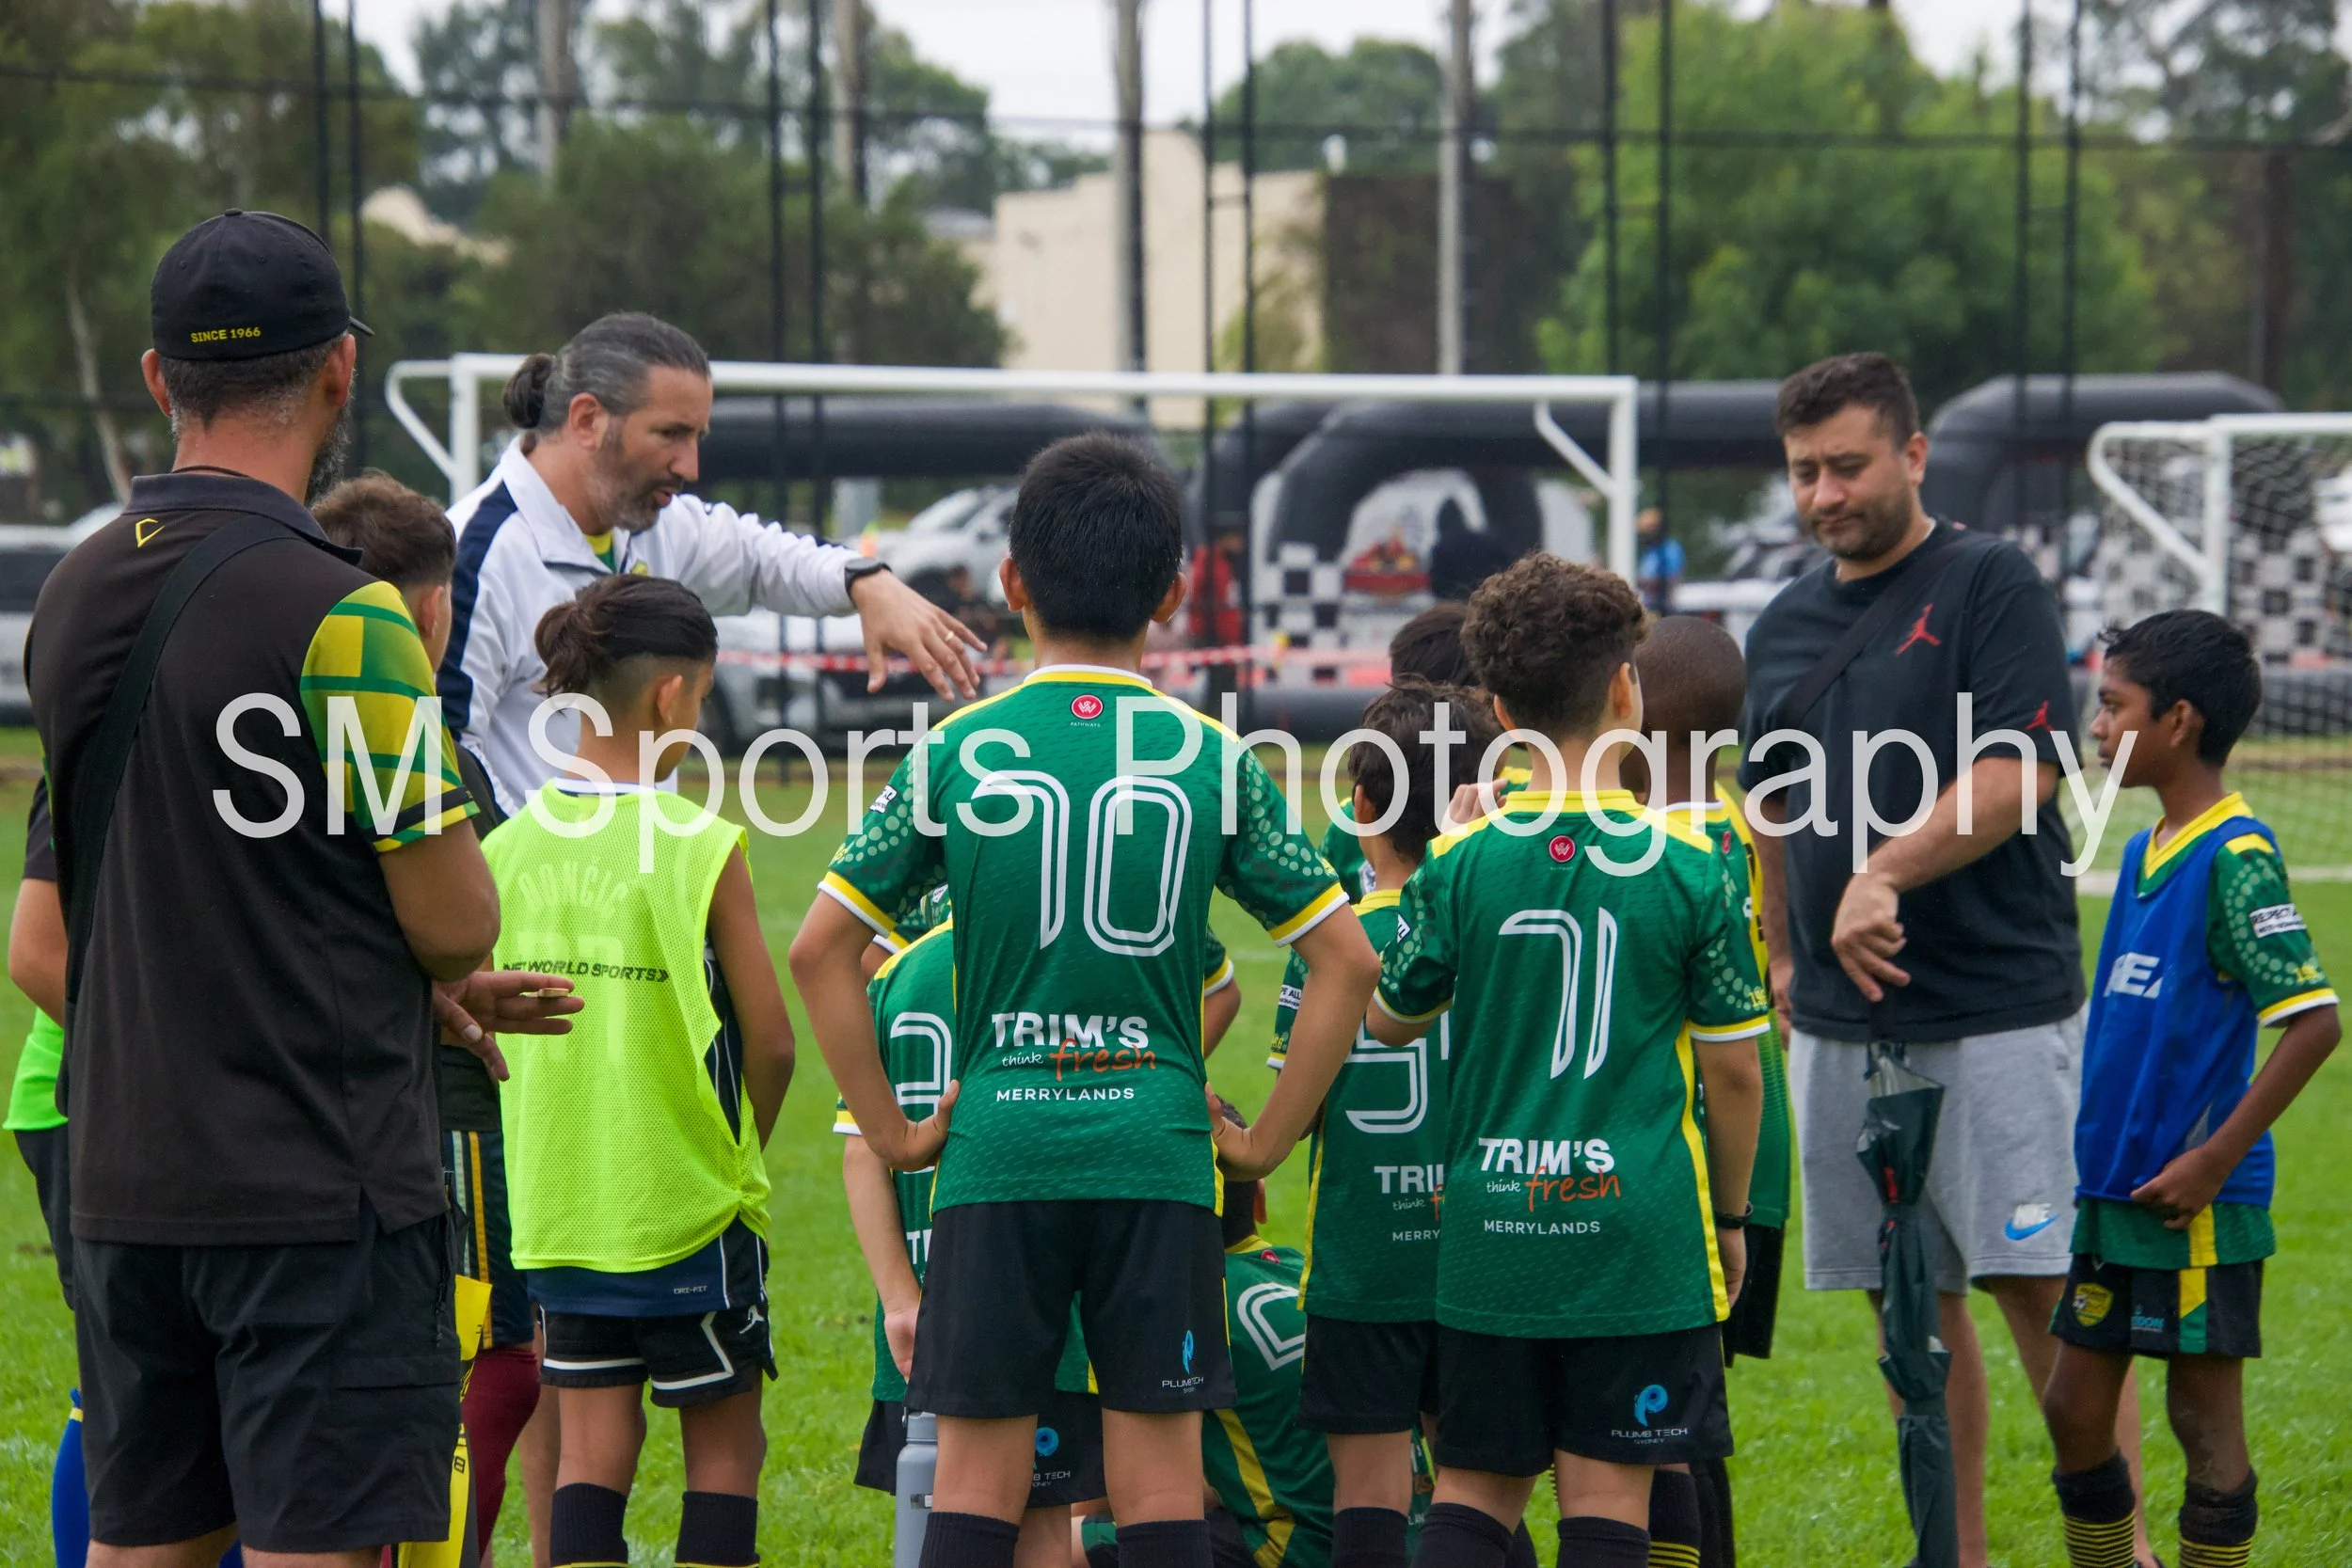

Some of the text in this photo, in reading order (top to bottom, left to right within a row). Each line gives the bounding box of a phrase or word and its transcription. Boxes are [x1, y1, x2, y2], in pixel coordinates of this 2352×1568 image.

[191, 326, 262, 343] SINCE 1966
[971, 769, 1193, 958] 10
[528, 960, 589, 975] WORLD
[592, 962, 658, 982] SPORTS
[1498, 907, 1618, 1080] 71
[992, 1011, 1150, 1049] TRIM'S
[1002, 1037, 1156, 1082] think fresh
[996, 1088, 1135, 1102] MERRYLANDS
[1478, 1137, 1615, 1176] TRIM'S
[1486, 1165, 1621, 1213] think fresh
[1392, 1197, 1426, 1212] think
[1484, 1220, 1600, 1235] MERRYLANDS
[1612, 1428, 1688, 1438] PLUMB TECH
[1044, 1470, 1071, 1480] TECH
